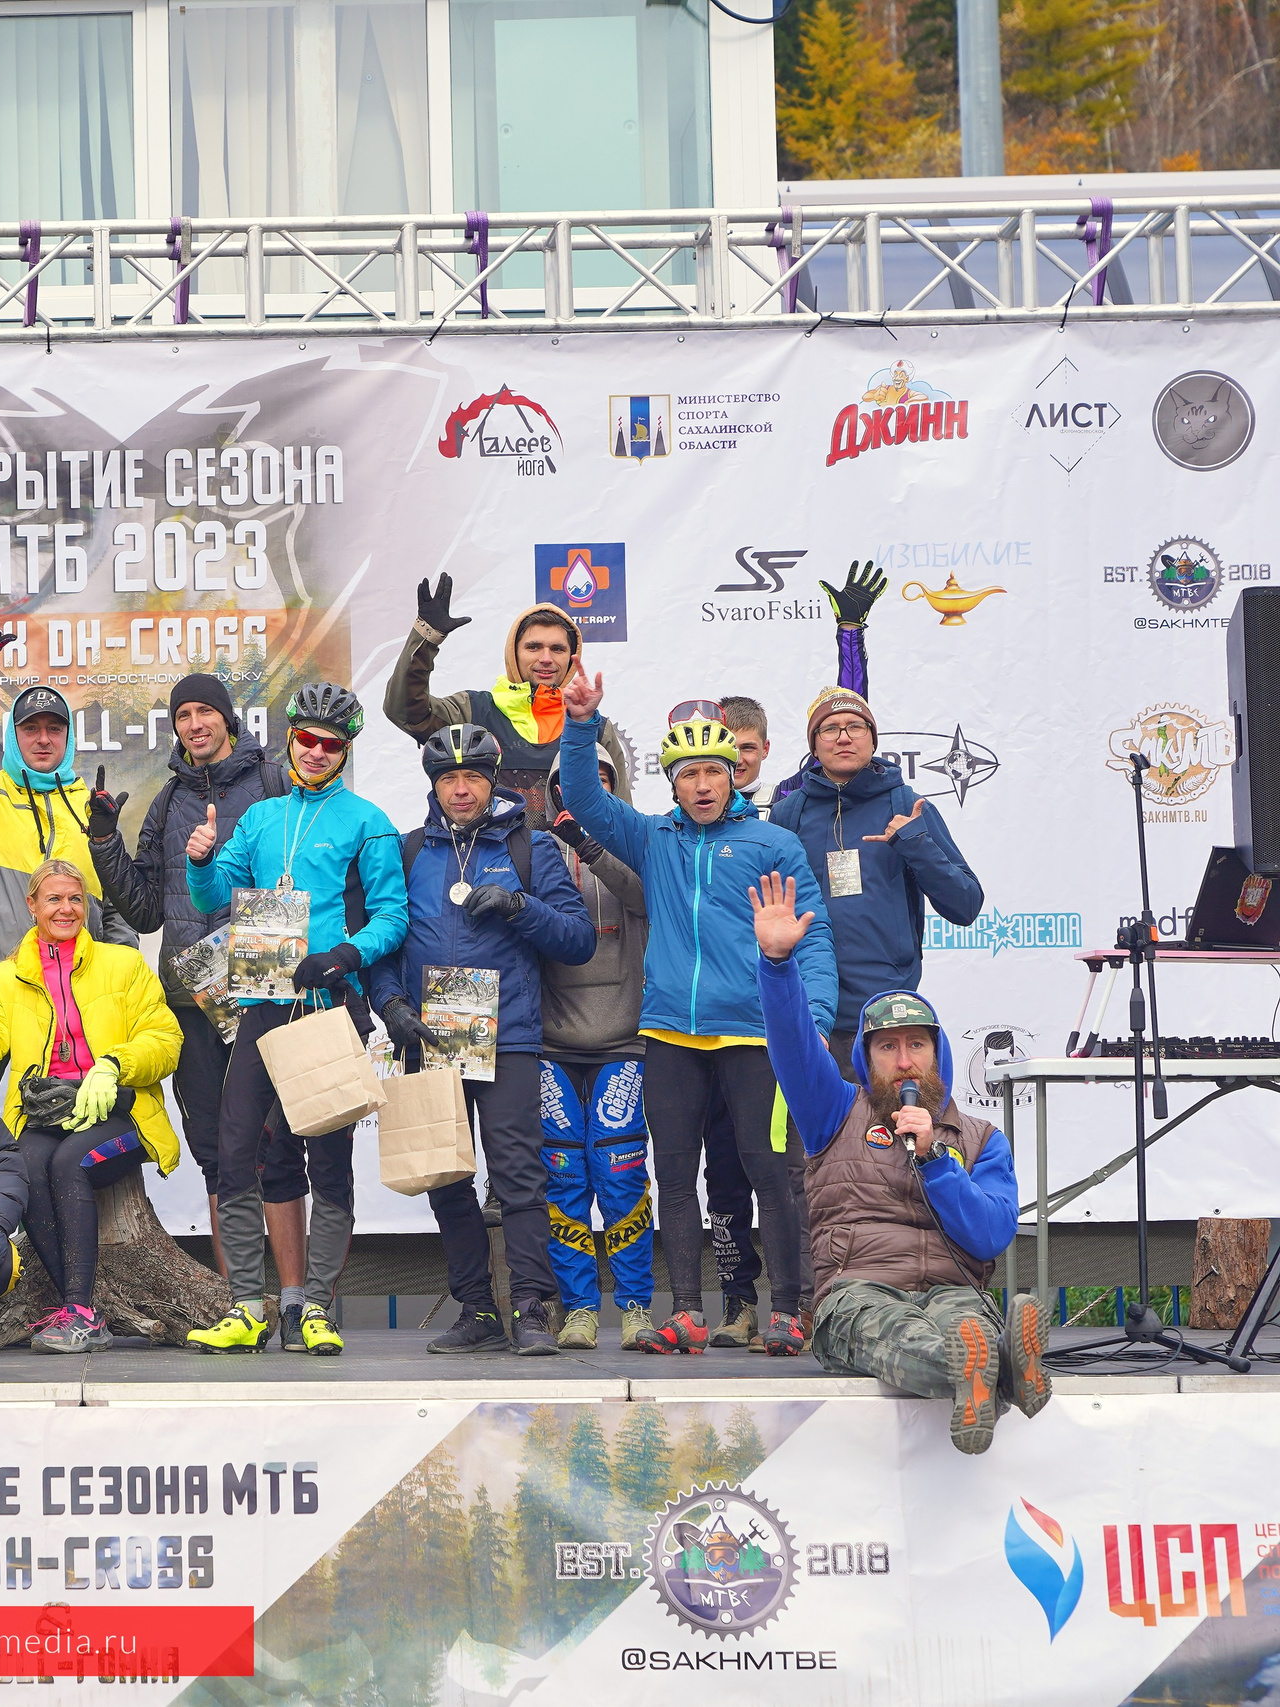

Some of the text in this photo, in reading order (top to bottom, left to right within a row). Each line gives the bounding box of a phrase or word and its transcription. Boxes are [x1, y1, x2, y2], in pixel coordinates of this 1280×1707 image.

[677, 393, 781, 405] МИНИСТЕРСТВО
[678, 410, 729, 421] СПОРТА
[1025, 403, 1107, 428] ЛИСТ
[678, 421, 773, 436] САХАЛИНСКОЙ
[679, 440, 737, 451] ОБЛАСТИ
[165, 444, 345, 507] СЕЗОНА
[113, 519, 268, 593] 2023
[876, 541, 1032, 570] ИЗОБИЛИЕ
[1103, 564, 1271, 583] EST. 2018
[701, 600, 823, 624] SvaroFskii
[48, 616, 267, 668] DH-CROSS
[48, 675, 69, 685] ПО
[27, 691, 57, 704] FOX
[1015, 914, 1081, 948] ЗВЕЗДА
[477, 1018, 489, 1036] 3
[41, 1465, 209, 1516] СЕЗОНА
[223, 1461, 319, 1515] МТБ
[555, 1541, 890, 1579] EST. 2018
[1103, 1523, 1247, 1627] ЦСП
[620, 1648, 837, 1672] @SAKHMTBE
